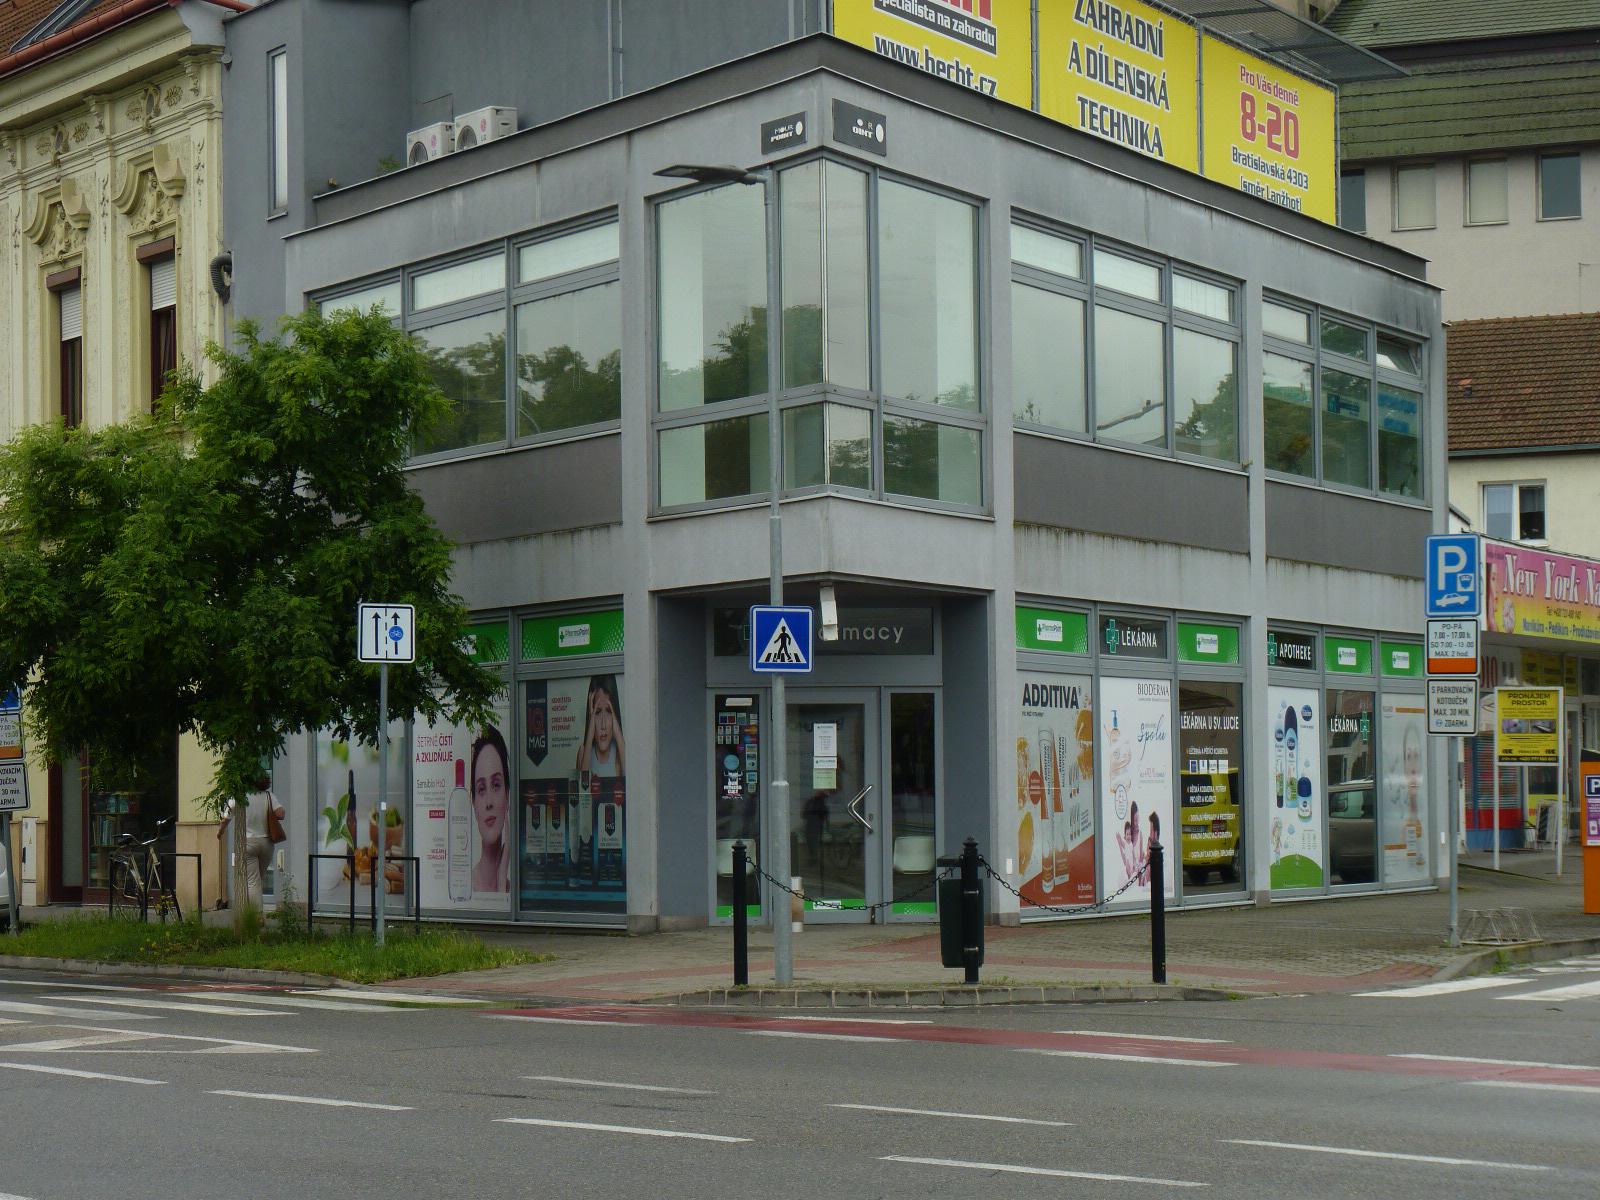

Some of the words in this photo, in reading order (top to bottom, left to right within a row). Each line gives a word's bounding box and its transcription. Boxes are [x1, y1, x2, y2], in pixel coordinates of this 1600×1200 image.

[881, 0, 935, 22] pecialista
[937, 12, 950, 28] na
[953, 18, 995, 46] zahradu
[1074, 0, 1163, 58] ZAHRADNÍ
[1068, 41, 1082, 74] A
[1086, 45, 1169, 111] DÍLENSKÁ
[1240, 65, 1255, 86] Pro
[1256, 76, 1272, 94] Vás
[1078, 96, 1163, 157] TECHNIKA
[1240, 91, 1299, 159] 8-20
[1232, 146, 1285, 181] Bratislavská
[1286, 168, 1308, 189] 4303
[1437, 545, 1467, 591] P
[1503, 552, 1538, 597] New
[1544, 560, 1580, 603] York
[818, 626, 904, 643] macy
[1122, 626, 1157, 648] LÉKÁRNA
[1279, 643, 1311, 661] APOTHEKE
[1137, 683, 1169, 697] BIODERMA
[1180, 711, 1207, 730] LÉKÁRNA
[1208, 716, 1213, 730] U
[1223, 716, 1239, 730] LUCIE
[1330, 715, 1358, 733] LÉKÁRNA
[1444, 719, 1468, 727] ZDARMA
[528, 735, 546, 749] MAG
